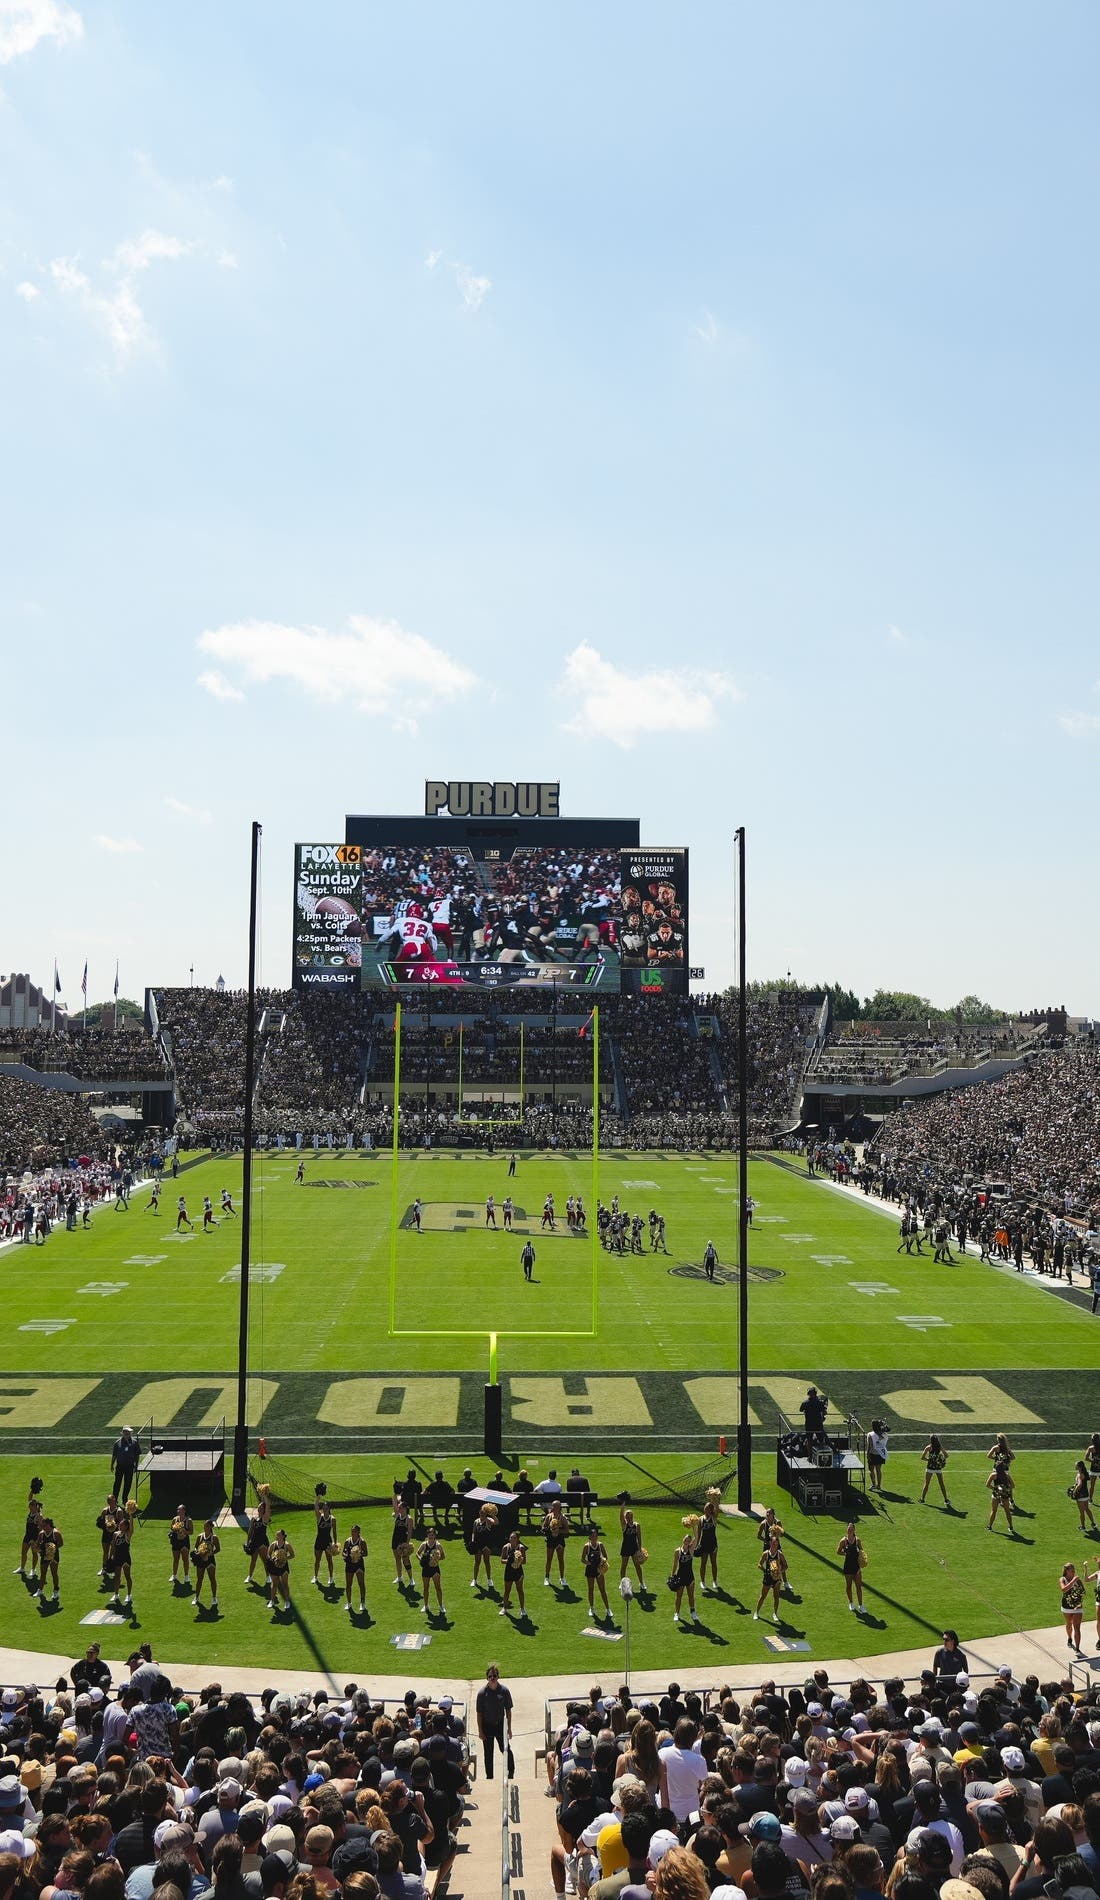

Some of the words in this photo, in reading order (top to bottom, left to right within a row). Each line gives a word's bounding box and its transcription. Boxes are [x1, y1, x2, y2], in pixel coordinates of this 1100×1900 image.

[425, 781, 560, 816] PURDUE
[301, 846, 338, 863] FOX
[340, 848, 359, 862] 16
[300, 871, 360, 888] Sunday
[307, 886, 329, 895] Sept.
[302, 912, 322, 921] 1pm
[403, 922, 428, 937] 32
[297, 935, 328, 944] 4:25pm
[406, 969, 413, 978] 7
[569, 970, 576, 980] 7
[691, 968, 703, 978] 26
